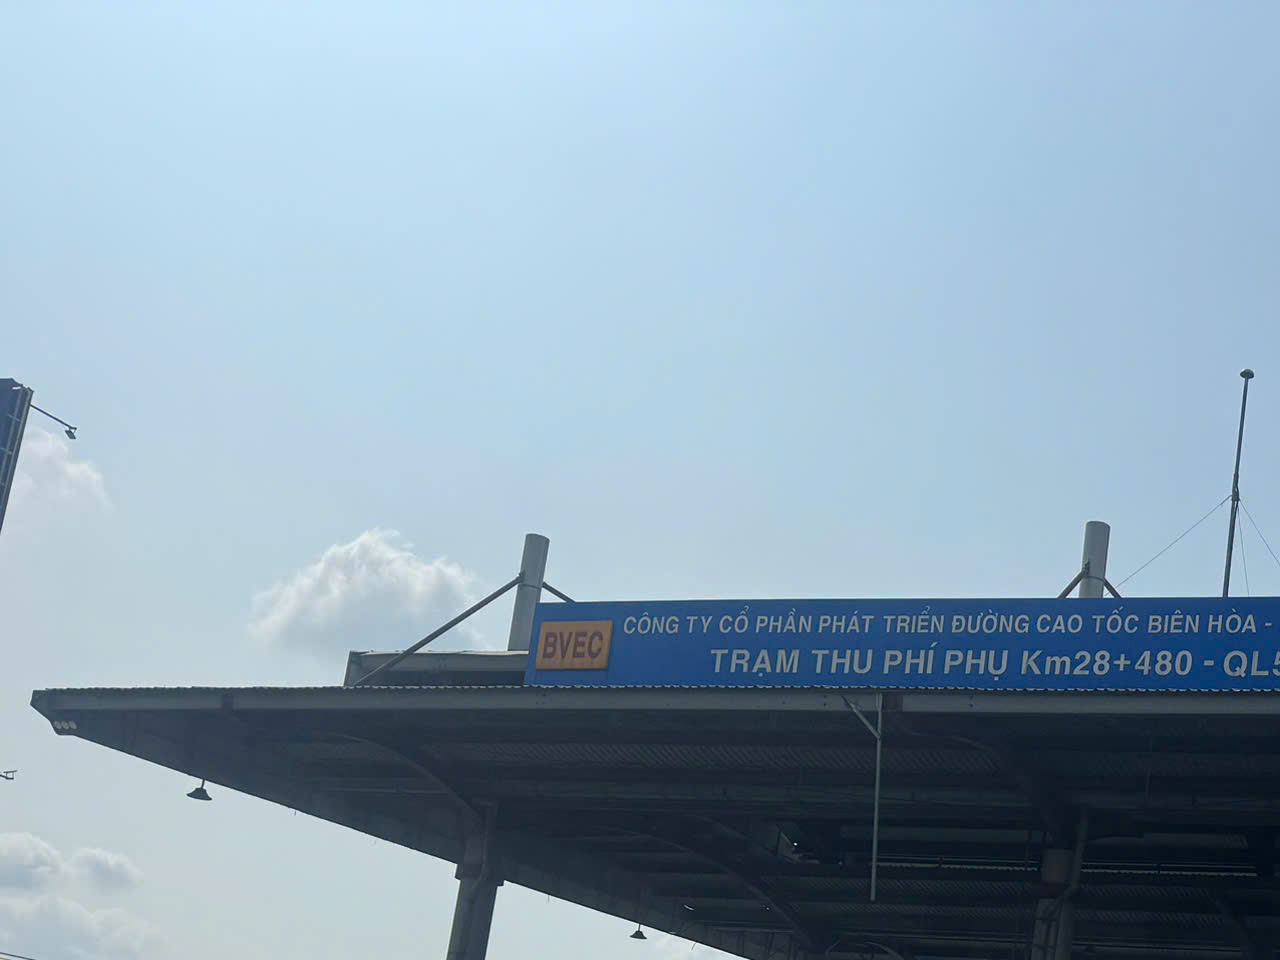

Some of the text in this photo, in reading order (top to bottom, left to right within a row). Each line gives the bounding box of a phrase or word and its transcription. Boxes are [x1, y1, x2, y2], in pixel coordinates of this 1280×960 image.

[623, 612, 680, 635] CÔNG
[686, 616, 713, 634] TY
[719, 605, 750, 634] CỔ
[755, 608, 813, 634] PHẦN
[818, 610, 874, 634] PHÁT
[883, 605, 945, 634] TRIỂN
[951, 609, 1030, 634] ĐƯỜNG
[1036, 614, 1083, 634] CAO
[1092, 606, 1140, 634] TỐC
[1147, 609, 1200, 634] BIÊN
[1207, 608, 1257, 634] HÒA
[542, 631, 604, 660] BVEC
[711, 648, 800, 678] TRẠM
[811, 648, 873, 675] THU
[883, 641, 939, 675] PHÍ
[943, 649, 1009, 681] PHỤ
[1020, 649, 1194, 677] Km28+480
[1203, 659, 1214, 667] -
